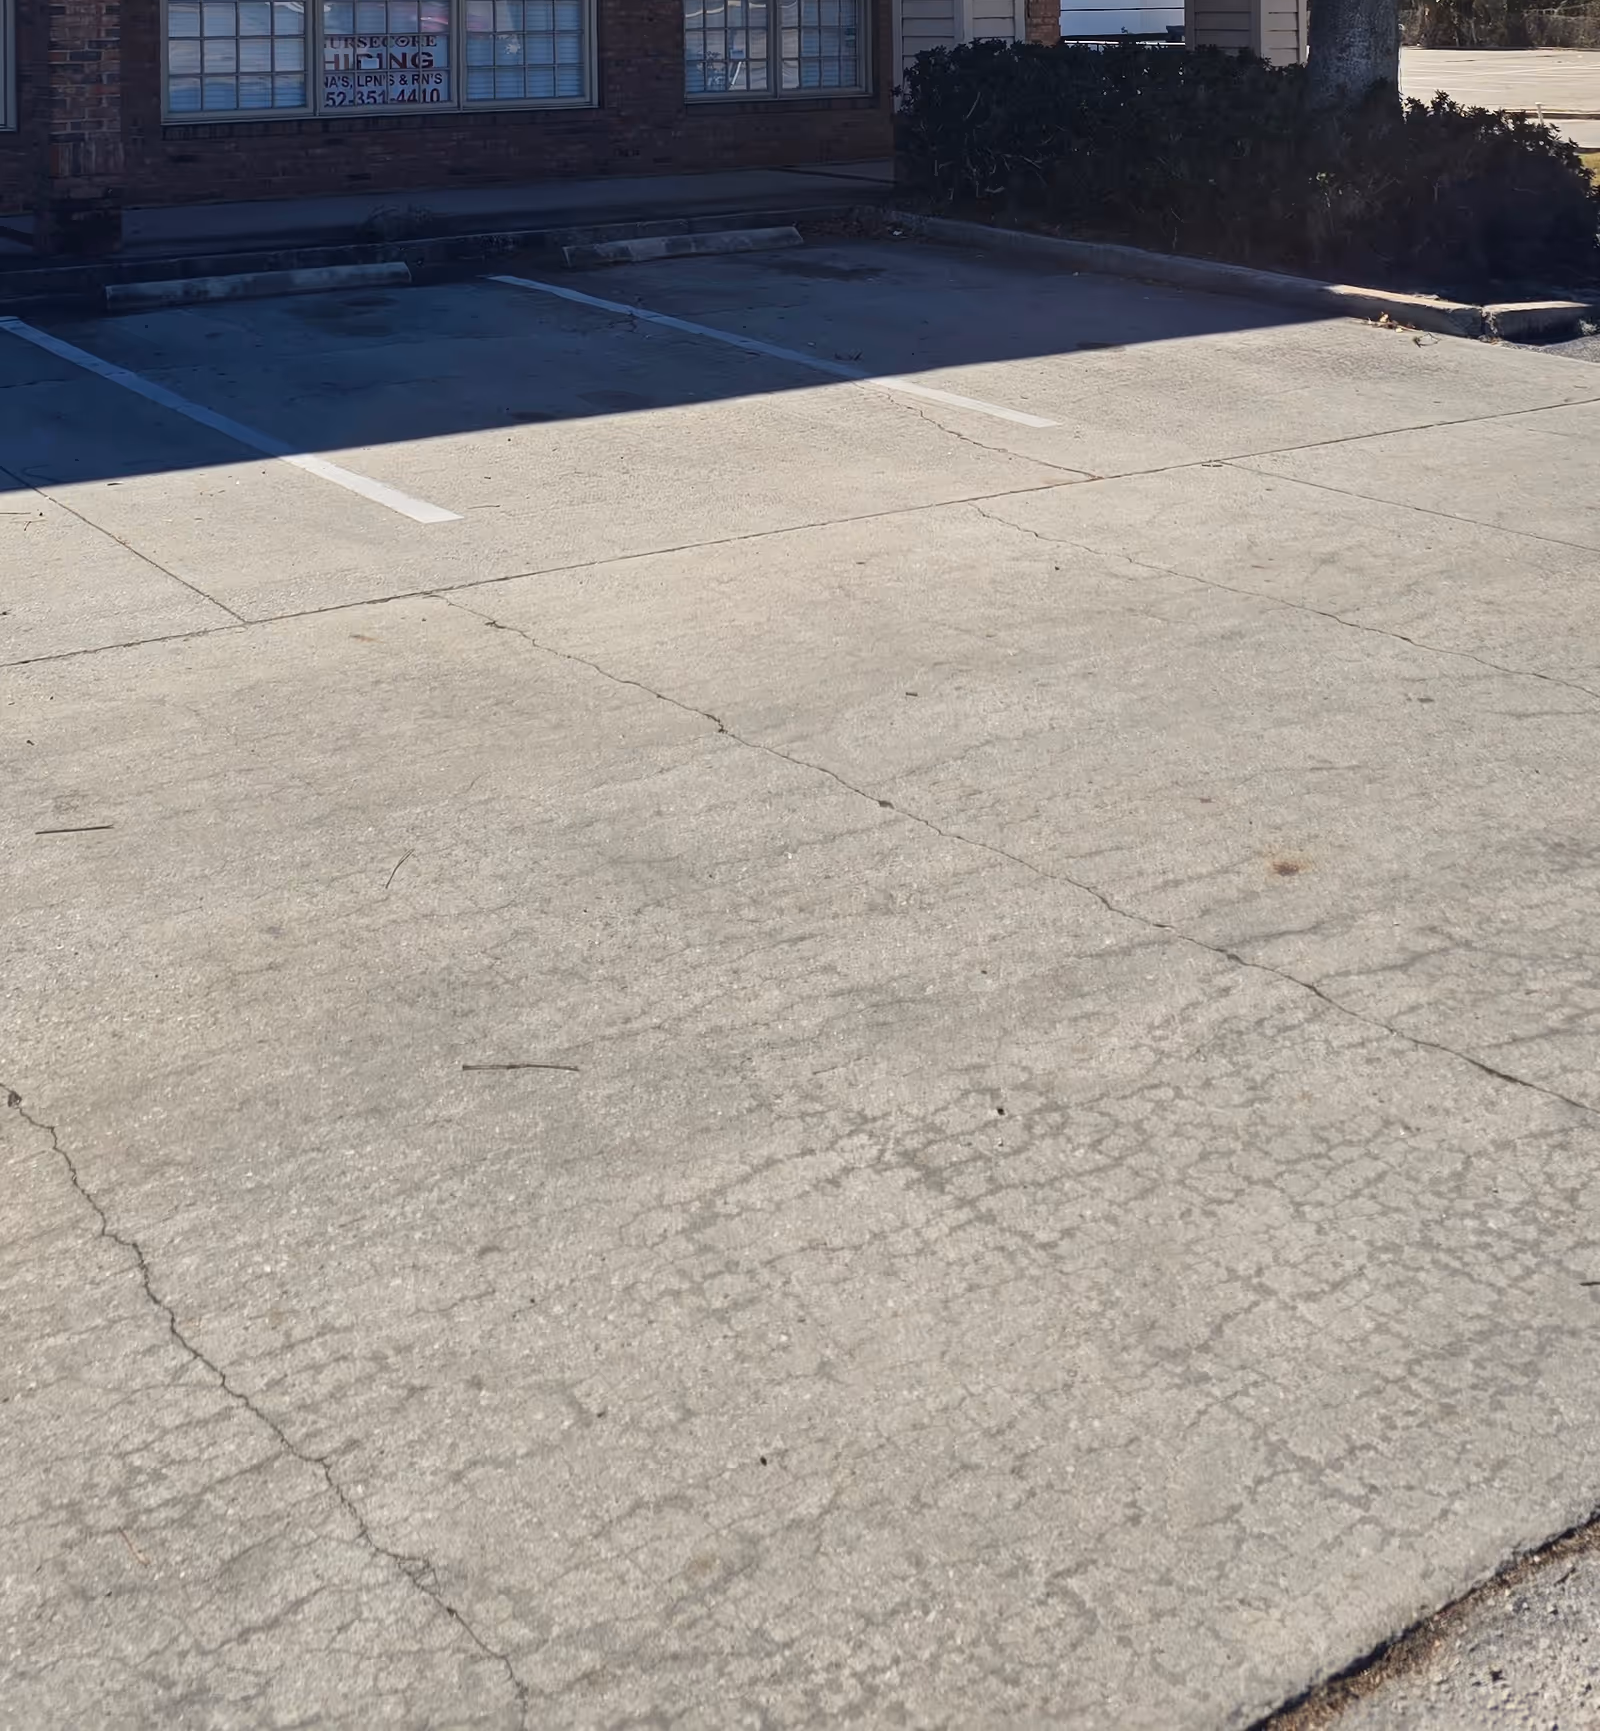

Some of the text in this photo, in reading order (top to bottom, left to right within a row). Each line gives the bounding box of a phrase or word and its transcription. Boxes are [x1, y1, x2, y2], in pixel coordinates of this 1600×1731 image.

[324, 35, 437, 49] URSECORE
[357, 74, 395, 87] LPN'S
[398, 73, 409, 85] &
[411, 72, 443, 85] RN'S
